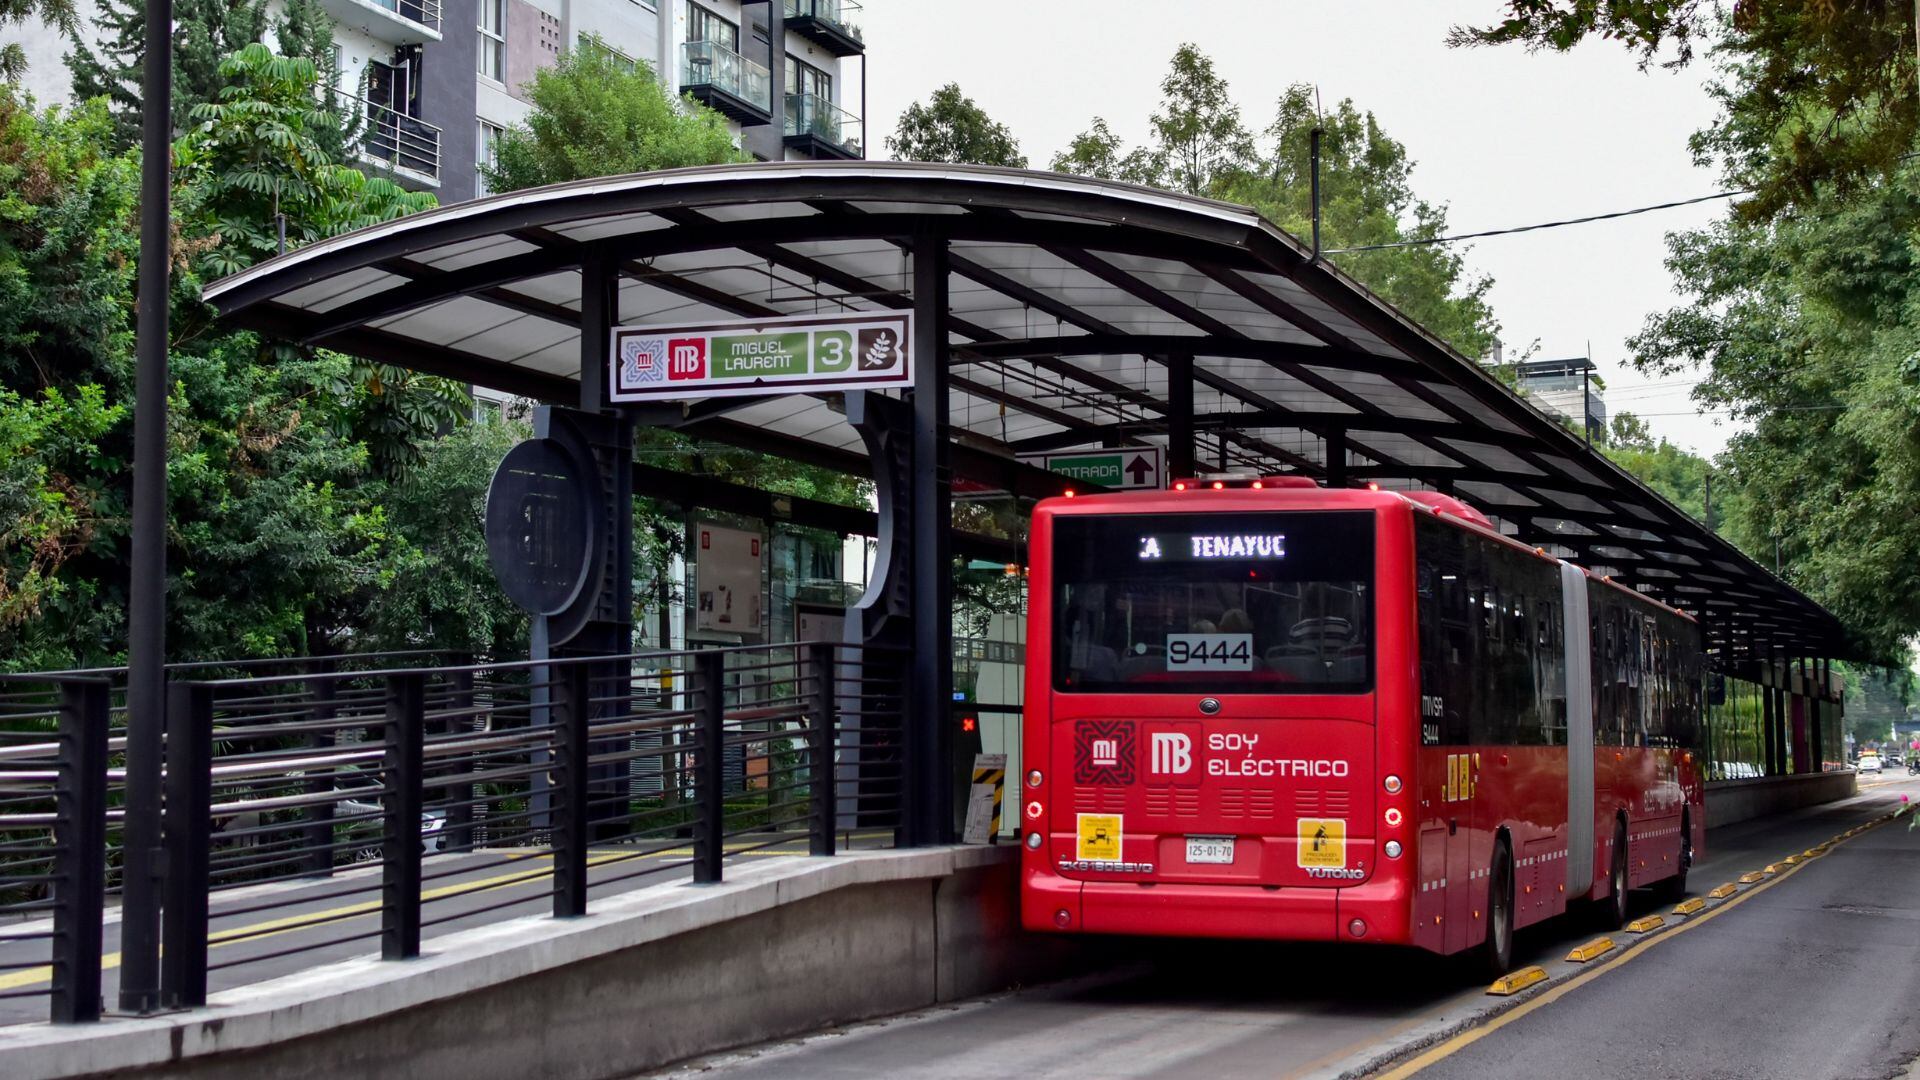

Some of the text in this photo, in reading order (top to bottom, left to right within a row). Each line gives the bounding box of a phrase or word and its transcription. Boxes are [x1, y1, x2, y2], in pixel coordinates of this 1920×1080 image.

[731, 340, 786, 356] MIGUEL
[821, 337, 841, 366] 3
[725, 354, 793, 371] LAURENT
[1192, 535, 1286, 557] TENAYUC
[1170, 640, 1250, 664] 9444
[1208, 733, 1259, 751] SOY
[1423, 723, 1439, 745] 9444
[1207, 753, 1349, 777] ELÉCTRICO
[1189, 845, 1232, 857] 125-01-70
[1305, 867, 1365, 879] YUTONG
